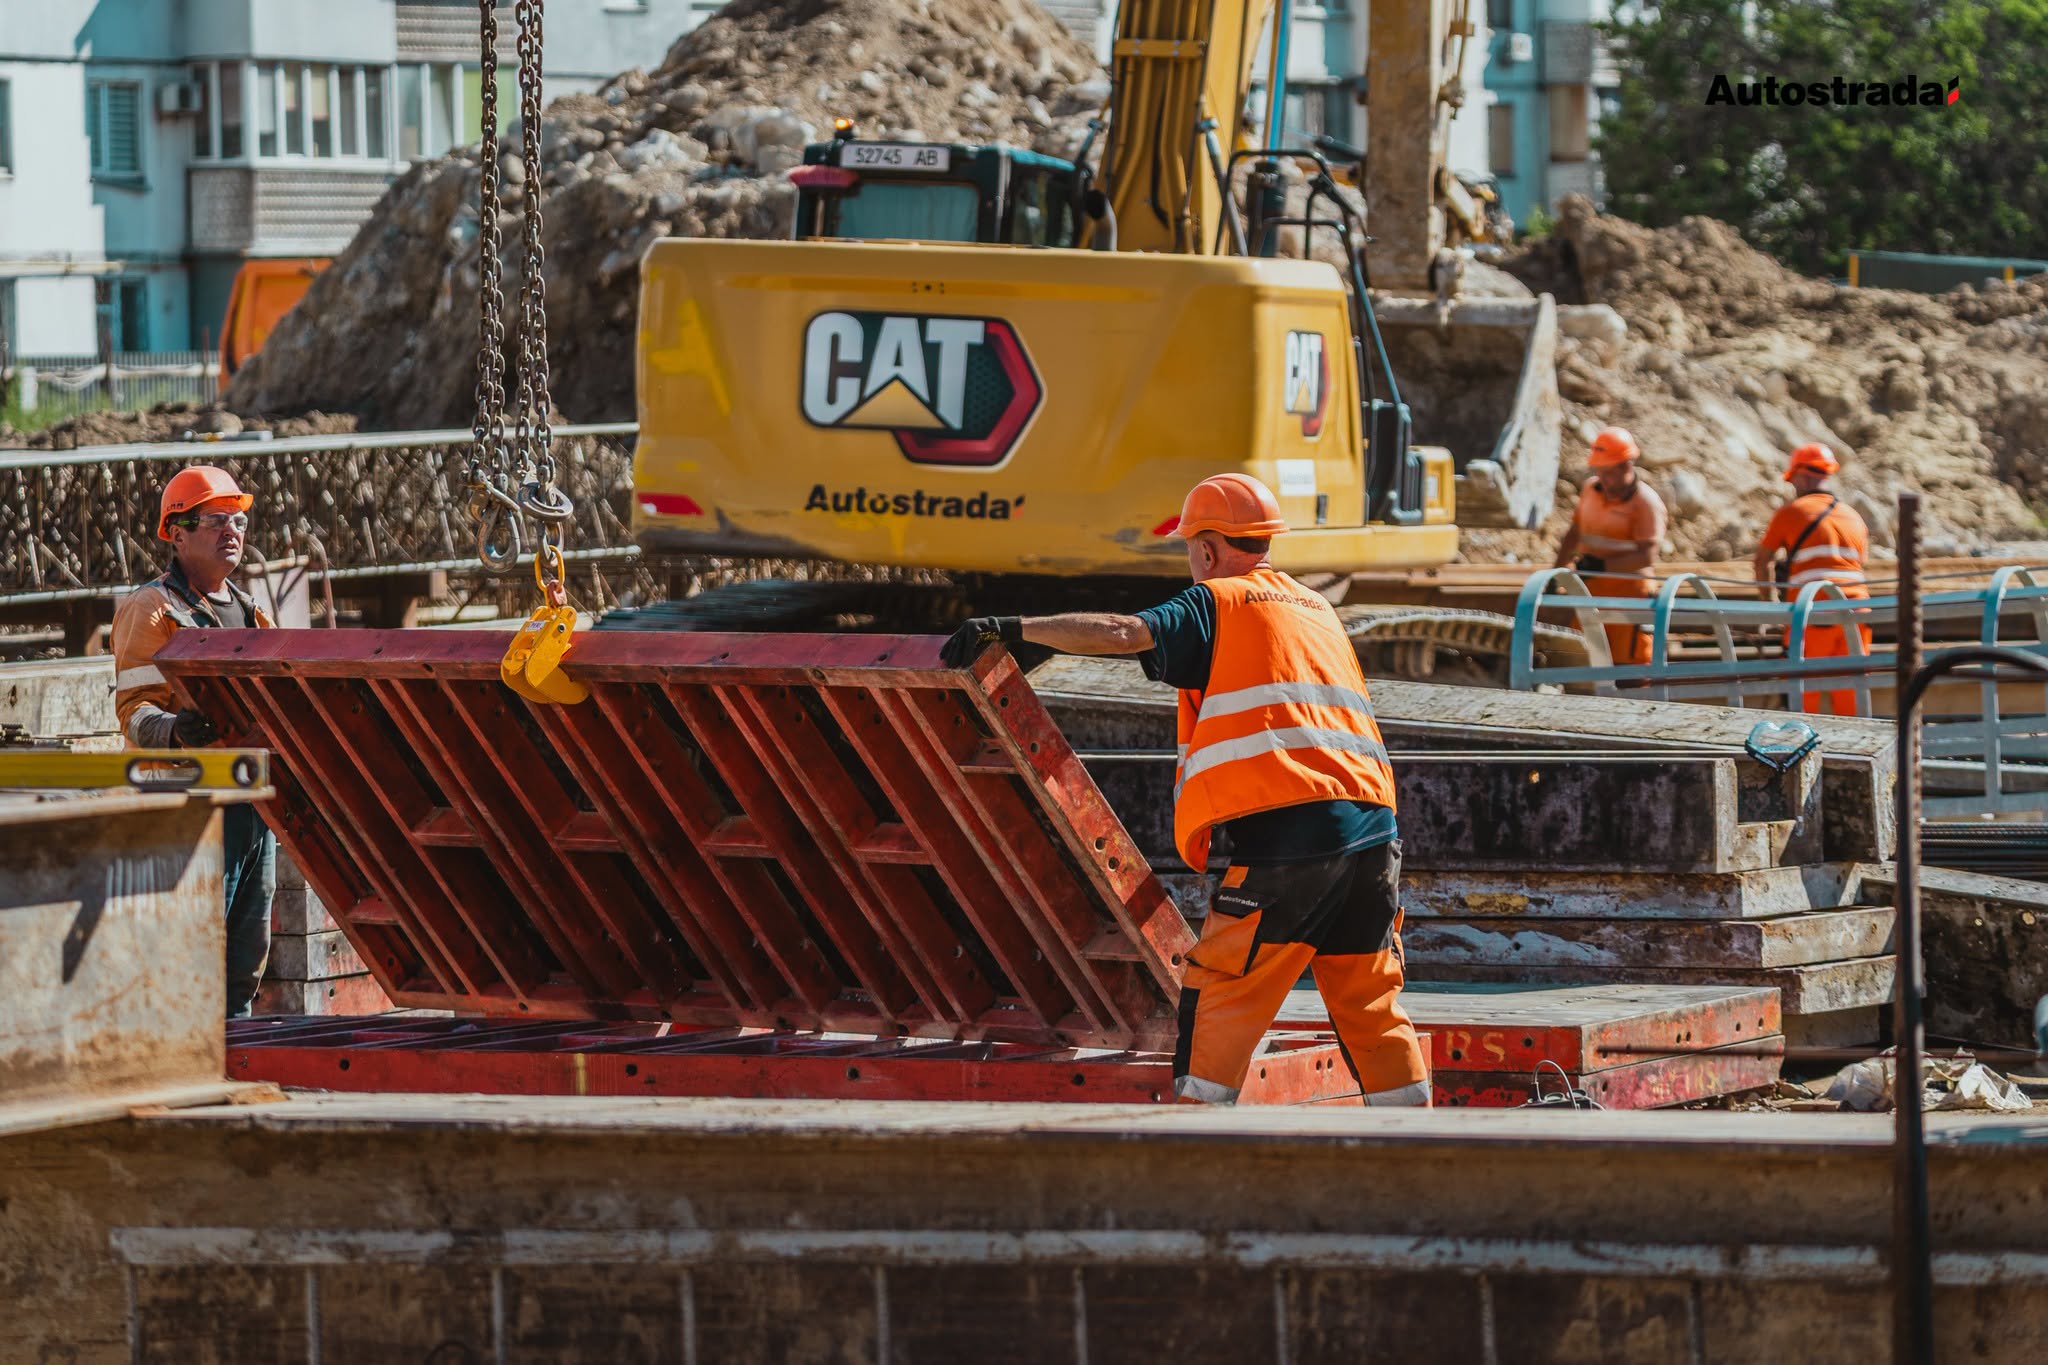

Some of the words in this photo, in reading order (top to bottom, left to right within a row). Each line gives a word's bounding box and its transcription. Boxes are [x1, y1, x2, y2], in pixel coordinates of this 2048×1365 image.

[855, 147, 902, 164] 52745
[913, 149, 938, 166] AB
[803, 311, 985, 430] CAT
[1284, 331, 1322, 413] CAT
[805, 483, 1010, 519] Autostrada
[1245, 589, 1323, 610] Autostrada
